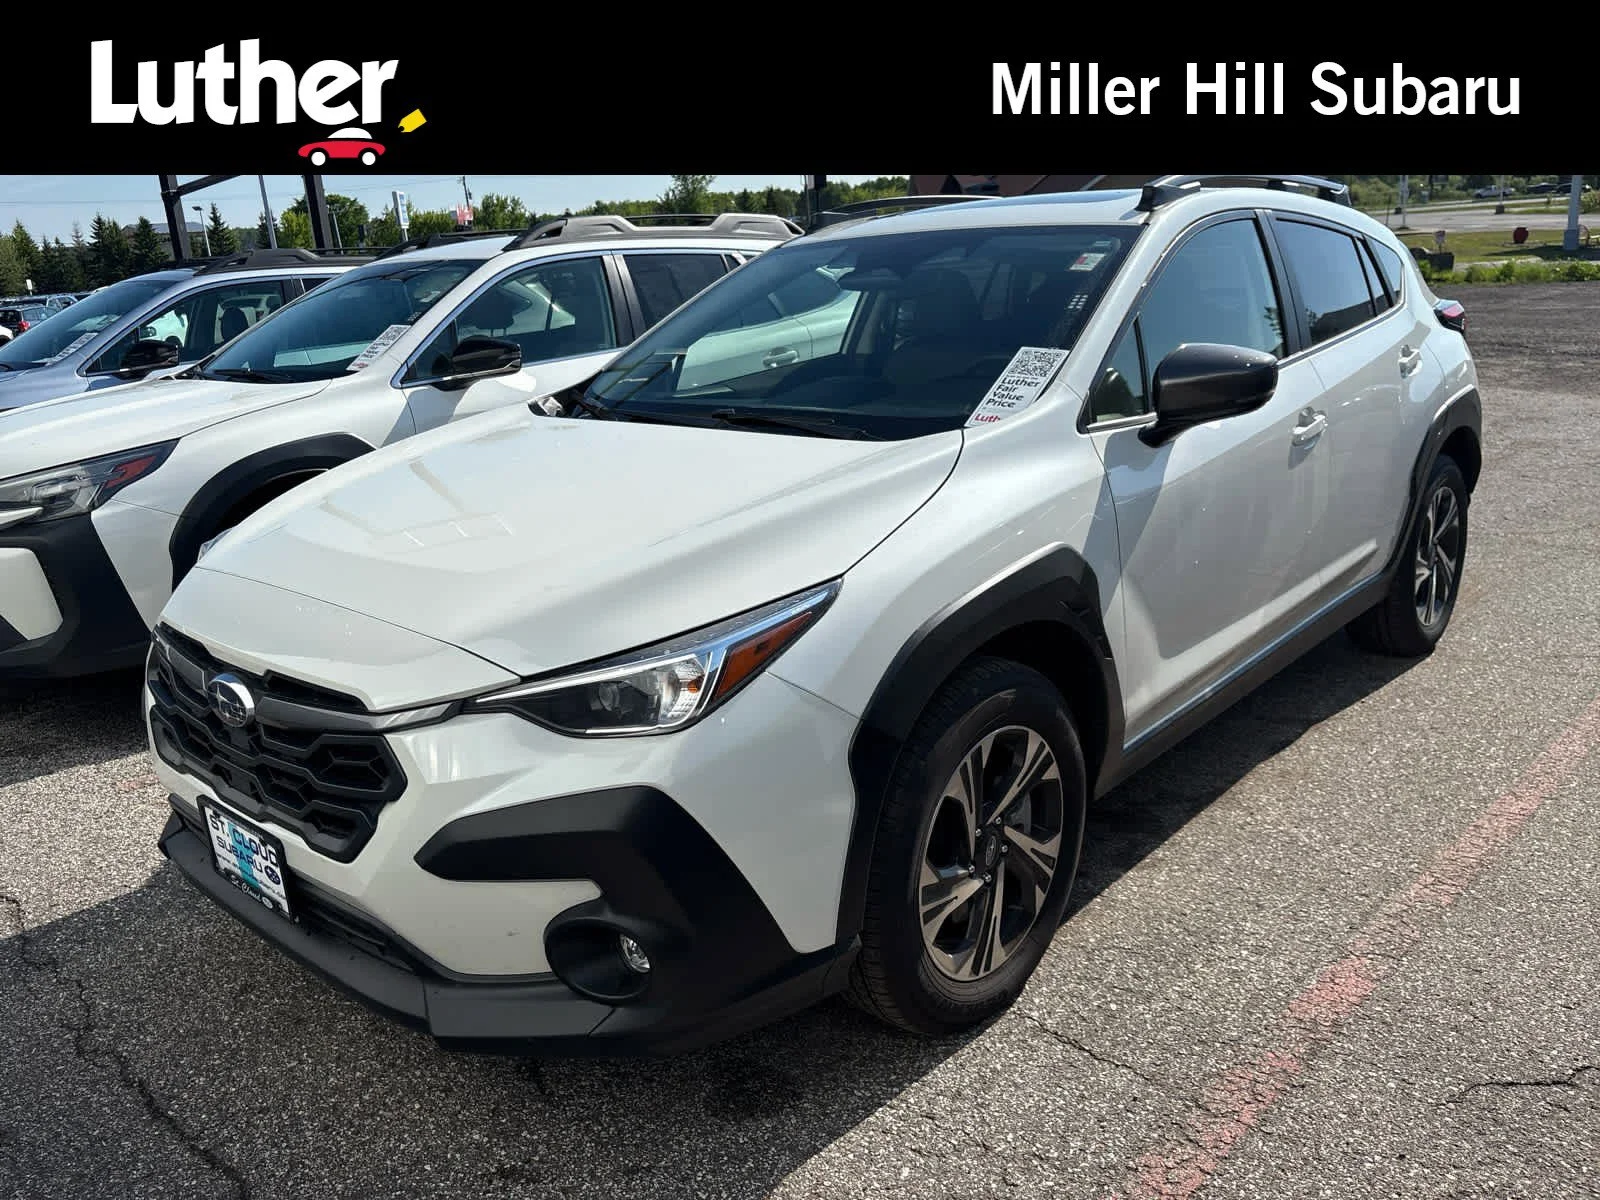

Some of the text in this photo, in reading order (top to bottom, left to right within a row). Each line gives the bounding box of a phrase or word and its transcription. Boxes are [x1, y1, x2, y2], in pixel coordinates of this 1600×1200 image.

[1001, 378, 1041, 387] Luther
[996, 384, 1019, 393] Fair
[992, 391, 1025, 401] Value
[985, 398, 1017, 408] Price
[231, 828, 279, 868] CLOUD
[216, 835, 264, 873] SUBARU
